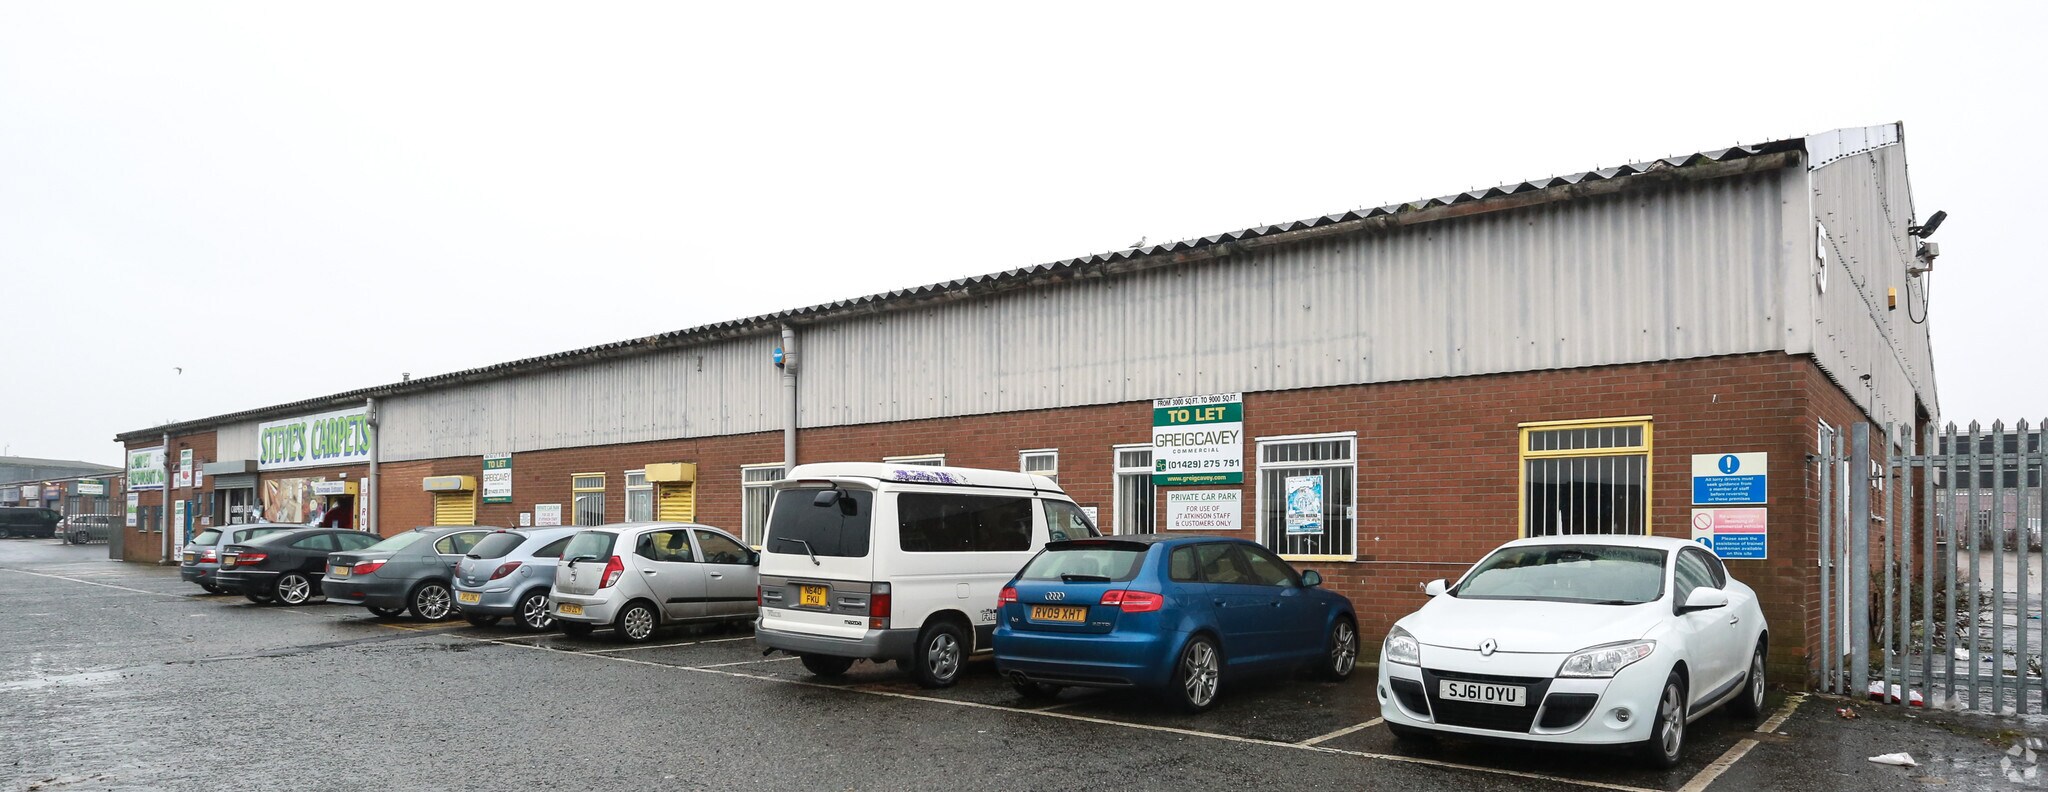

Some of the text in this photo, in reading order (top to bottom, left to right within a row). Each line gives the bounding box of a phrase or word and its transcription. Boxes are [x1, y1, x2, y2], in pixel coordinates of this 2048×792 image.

[1818, 222, 1826, 293] 5
[1168, 407, 1226, 422] TO LET
[260, 414, 370, 464] STEVE'S CARPETS
[1156, 430, 1239, 447] GREIGCAVEY
[1168, 460, 1201, 469] (01429)
[806, 595, 820, 604] FKU
[1035, 606, 1082, 620] RV09 XHT
[1449, 683, 1516, 702] SJ61 OYU
